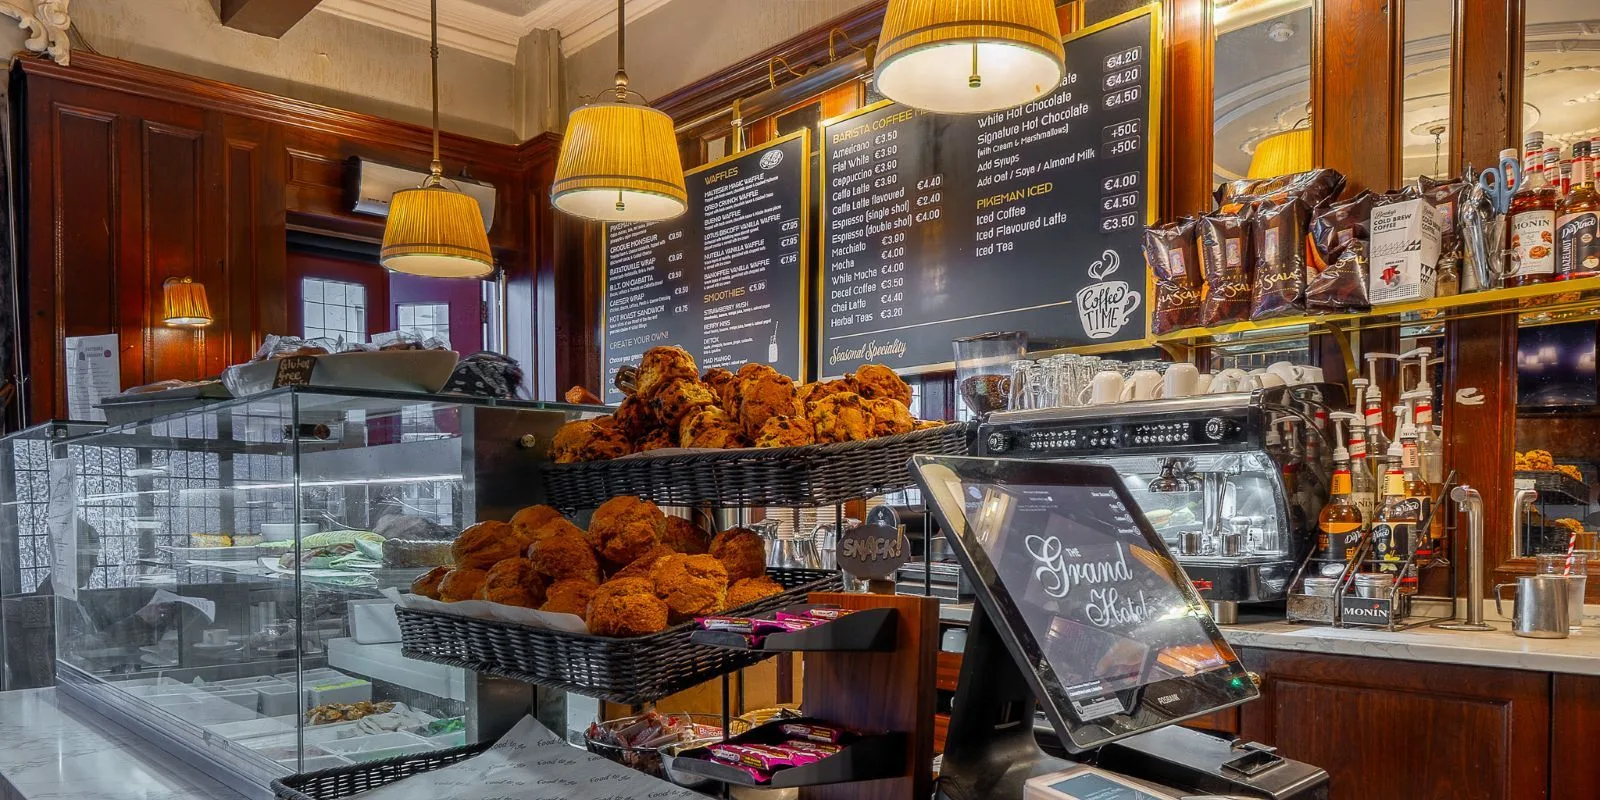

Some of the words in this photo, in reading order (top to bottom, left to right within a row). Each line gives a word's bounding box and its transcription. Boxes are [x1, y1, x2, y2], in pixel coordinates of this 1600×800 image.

[1107, 49, 1138, 68] €4.20
[1106, 69, 1138, 87] €4.20
[1106, 89, 1138, 107] €4.50
[978, 113, 1003, 128] White
[1007, 106, 1023, 120] Hot
[1025, 91, 1072, 114] Chocolate
[832, 125, 870, 144] BARISTA
[872, 109, 912, 130] COFFEE
[977, 124, 1019, 144] Signature
[1022, 117, 1039, 131] Hot
[1041, 102, 1089, 126] Chocolate
[832, 141, 869, 159] Americano
[875, 130, 897, 145] €3.50
[977, 145, 991, 158] (with
[993, 141, 1013, 152] Cream
[1015, 139, 1019, 147] &
[1021, 123, 1068, 145] Marshmallows)
[832, 162, 847, 173] Flat
[848, 154, 869, 168] White
[977, 160, 992, 172] Add
[994, 154, 1020, 169] Syrups
[977, 175, 991, 188] Add
[994, 171, 1008, 183] Oat
[1016, 164, 1035, 179] Soya
[1043, 153, 1075, 170] Almond
[1077, 148, 1095, 160] Milk
[704, 167, 738, 185] WAFFLES
[745, 173, 764, 184] WAFFLE
[832, 168, 872, 188] Cappuccino
[1104, 174, 1137, 190] €4.00
[739, 190, 758, 201] WAFFLE
[852, 197, 869, 210] Latte
[872, 187, 904, 205] flavoured
[917, 176, 940, 190] €4.40
[853, 183, 870, 196] Latte
[976, 191, 1025, 209] PIKEMAN
[1027, 182, 1053, 199] ICED
[832, 214, 863, 230] Espresso
[866, 205, 889, 222] (single
[891, 200, 909, 214] shot)
[917, 192, 940, 207] €2.40
[1104, 194, 1135, 210] €4.50
[704, 216, 721, 225] BUENO
[722, 210, 741, 220] WAFFLE
[760, 214, 780, 223] WAFFLE
[976, 213, 994, 225] Iced
[997, 205, 1026, 221] Coffee
[1103, 215, 1135, 230] €3.50
[832, 230, 863, 244] Espresso
[866, 222, 892, 237] (double
[894, 214, 912, 228] shot)
[916, 209, 939, 223] €4.00
[976, 228, 994, 241] Iced
[996, 216, 1041, 235] Flavoured
[1043, 212, 1067, 226] Latte
[1374, 223, 1396, 231] COFFEE
[1514, 220, 1550, 230] MONIN
[1562, 217, 1596, 239] DaVinci
[704, 250, 724, 260] NUTELLA
[745, 239, 764, 249] WAFFLE
[832, 242, 866, 257] Macchiato
[976, 245, 993, 257] Iced
[996, 240, 1014, 252] Tea
[1562, 240, 1571, 273] HAZELNUT
[750, 259, 770, 268] WAFFLE
[832, 259, 854, 272] Mocha
[882, 247, 904, 260] €4.00
[832, 275, 852, 285] White
[854, 268, 878, 280] Mocha
[881, 262, 904, 274] €4.00
[704, 287, 745, 303] SMOOTHIES
[832, 288, 851, 299] Decaf
[854, 283, 876, 294] Coffee
[1082, 287, 1125, 313] Coffee
[704, 304, 734, 315] STRAWBERRY
[832, 302, 847, 313] Chai
[849, 299, 866, 310] Latte
[881, 292, 903, 304] €4.40
[610, 315, 619, 323] HOT
[620, 311, 636, 319] ROAST
[637, 305, 664, 316] SANDWICH
[831, 315, 853, 327] Herbal
[856, 313, 873, 322] Teas
[881, 308, 902, 319] €3.20
[1084, 308, 1119, 330] TIME
[610, 338, 632, 349] CREATE
[634, 335, 649, 345] YOUR
[714, 355, 731, 363] MANGO
[830, 343, 866, 365] Seasonal
[865, 339, 906, 361] Speciality
[843, 524, 906, 563] SNACK!
[1066, 548, 1081, 558] THE
[1025, 535, 1133, 598] Grand
[1085, 588, 1149, 627] Hotel
[1344, 607, 1388, 618] MONIN
[537, 737, 556, 747] Food
[590, 774, 611, 782] Food
[648, 789, 670, 798] Food
